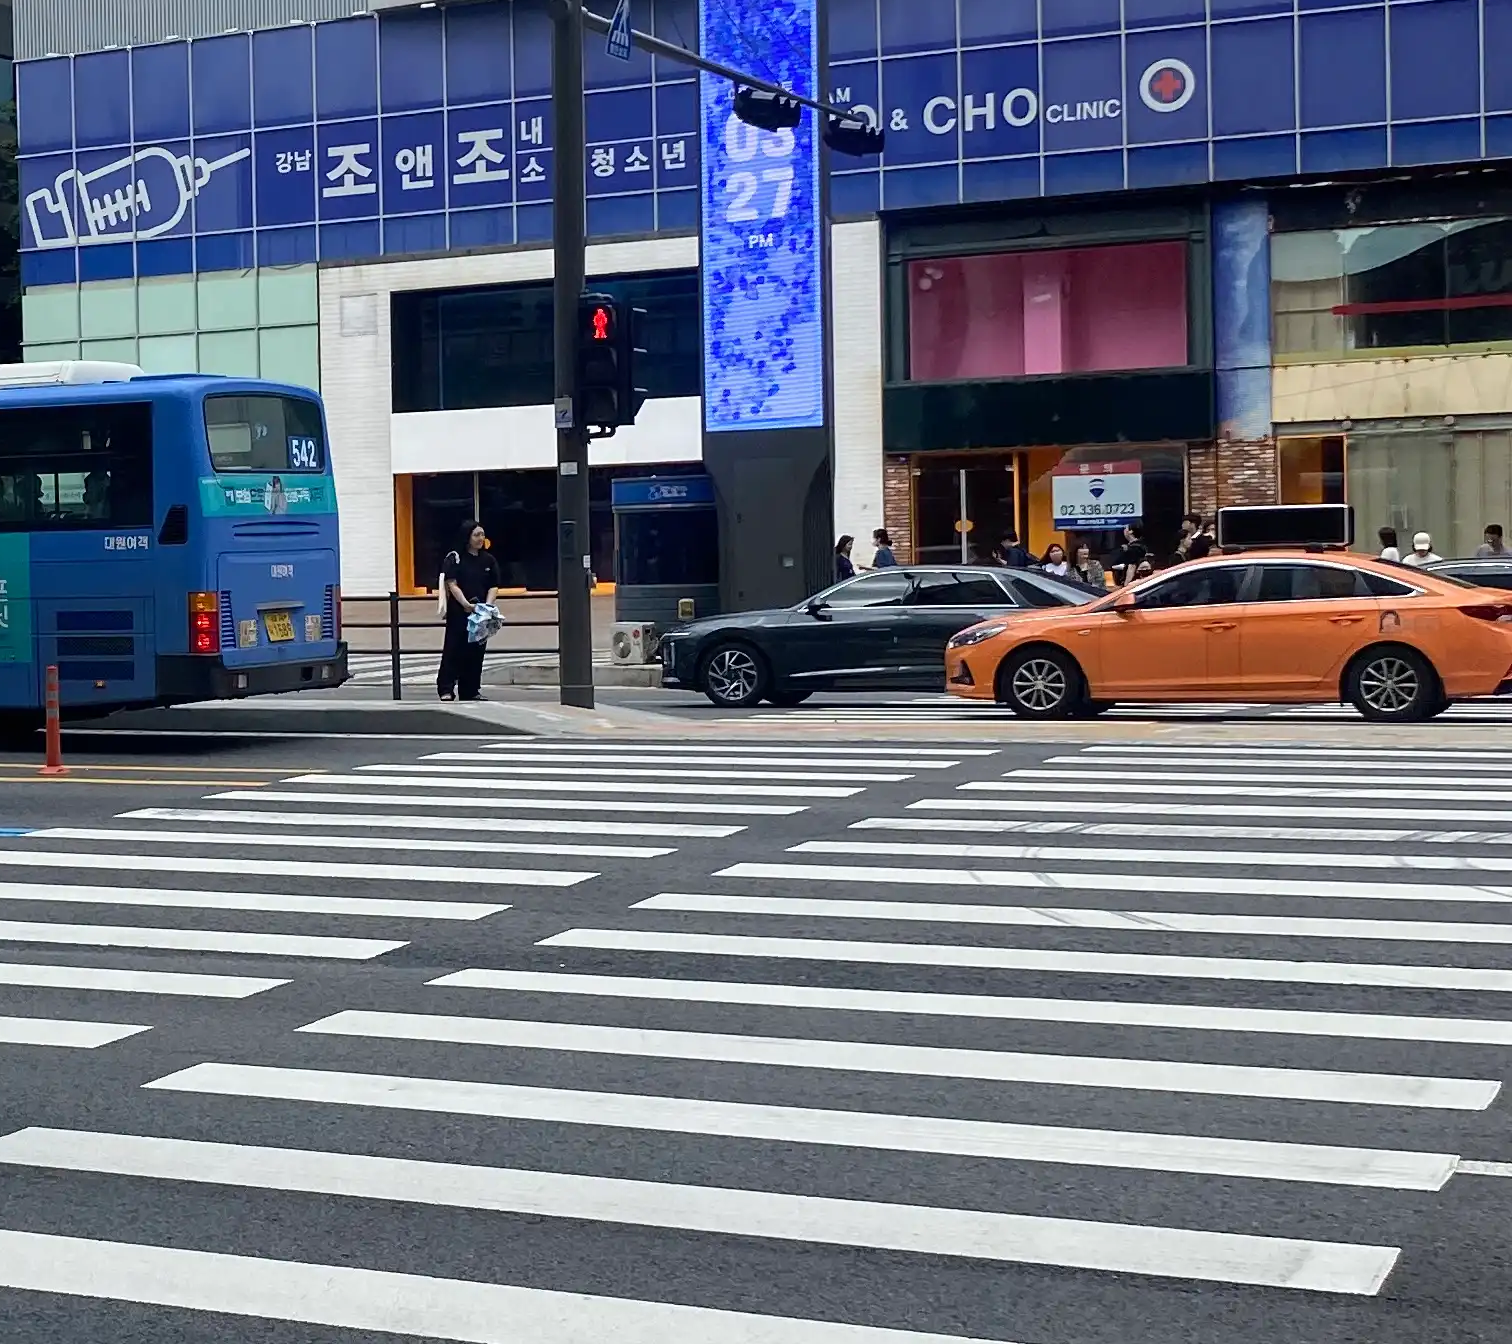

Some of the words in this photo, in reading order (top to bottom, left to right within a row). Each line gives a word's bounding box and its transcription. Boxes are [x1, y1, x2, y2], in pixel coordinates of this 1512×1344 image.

[889, 108, 909, 131] &
[923, 87, 1038, 135] CHO
[1045, 98, 1121, 123] CLINIC
[275, 150, 312, 173] 강남
[726, 166, 795, 223] 27
[748, 233, 774, 248] PM
[292, 439, 317, 467] 542
[104, 535, 149, 550] 대원여객
